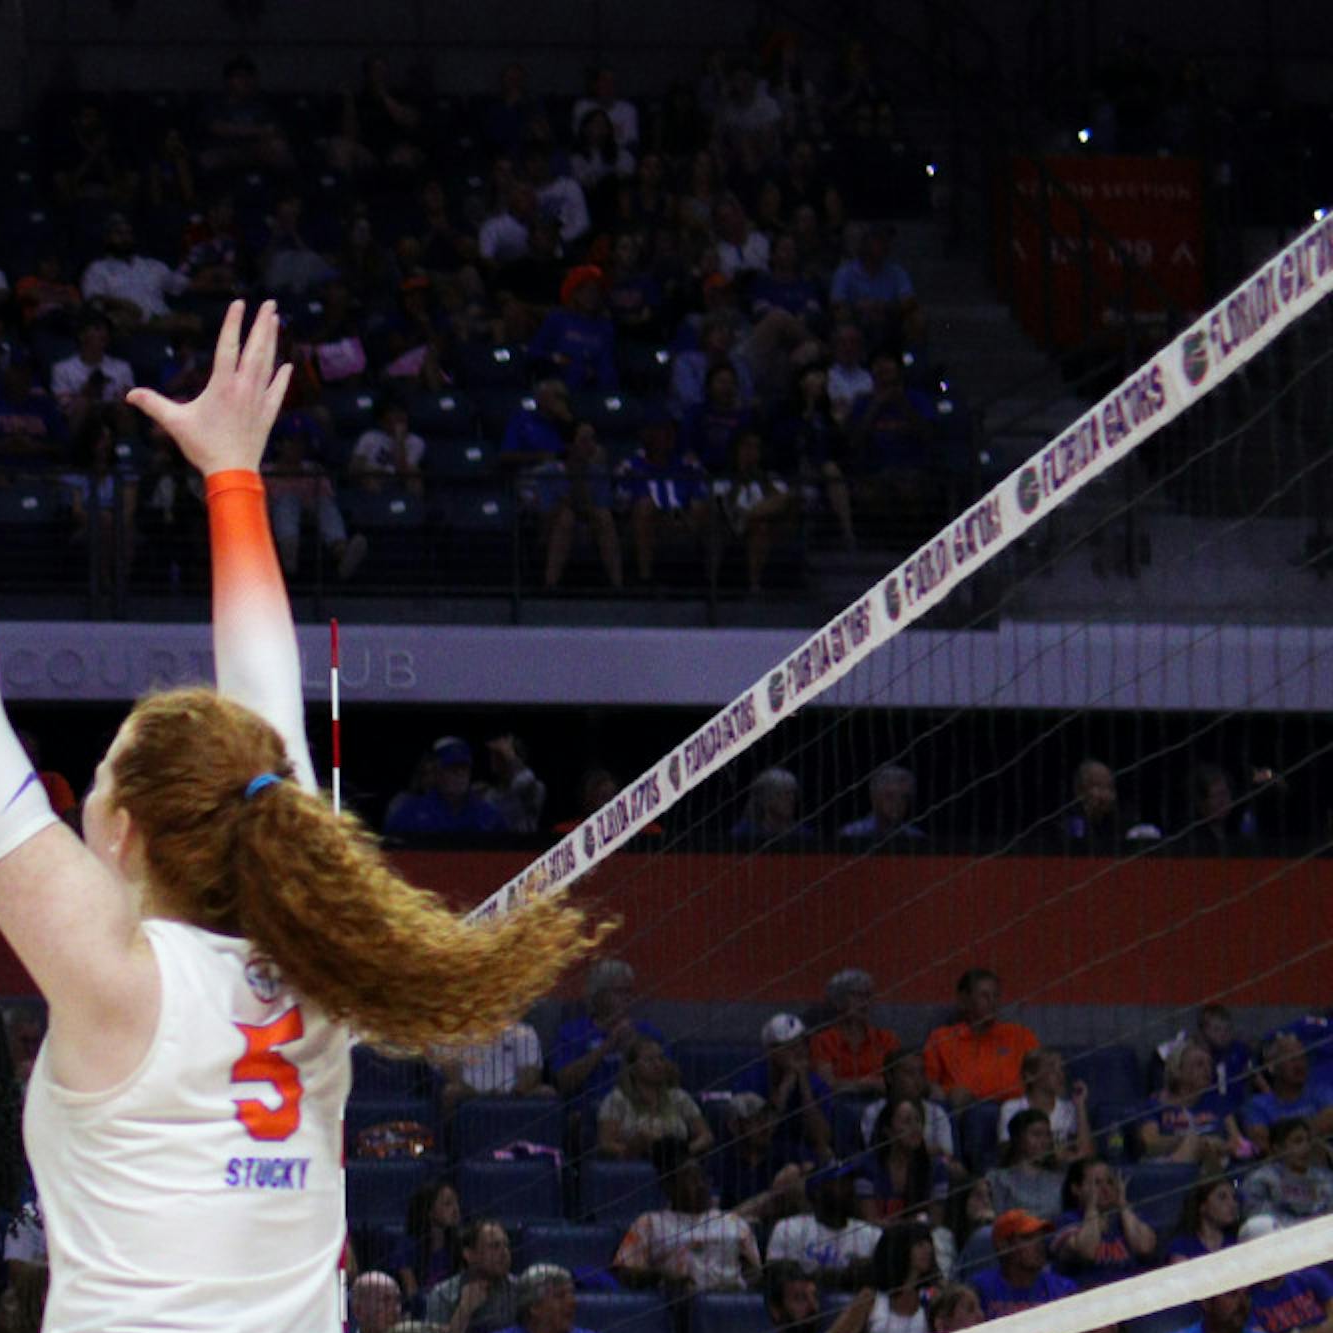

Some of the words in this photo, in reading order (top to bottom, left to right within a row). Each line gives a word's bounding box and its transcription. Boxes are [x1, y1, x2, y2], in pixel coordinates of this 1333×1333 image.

[300, 652, 417, 691] LUB
[231, 1003, 304, 1141] 5
[225, 1157, 312, 1190] STUCKY
